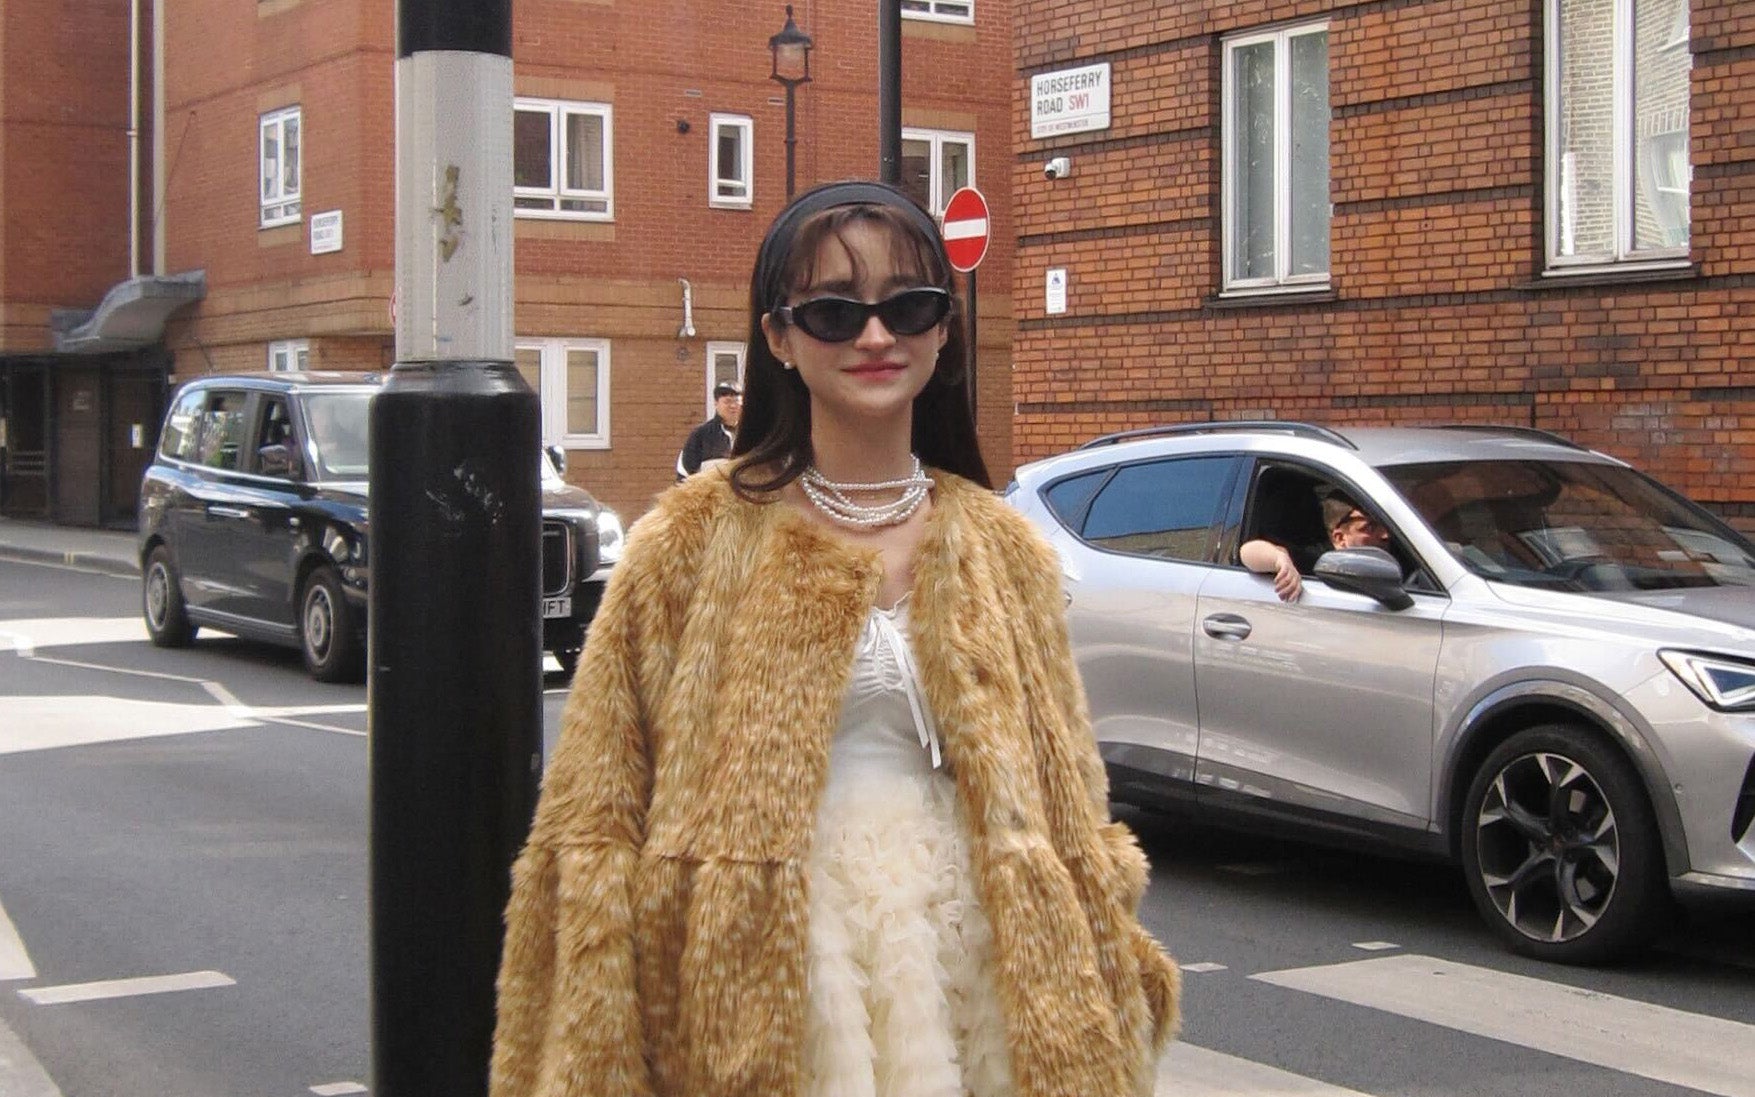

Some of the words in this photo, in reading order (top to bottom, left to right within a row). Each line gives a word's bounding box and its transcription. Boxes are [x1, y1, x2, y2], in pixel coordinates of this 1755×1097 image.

[1036, 70, 1102, 96] HORSEFERRY
[1036, 97, 1063, 116] ROAD
[1068, 93, 1089, 111] SW1
